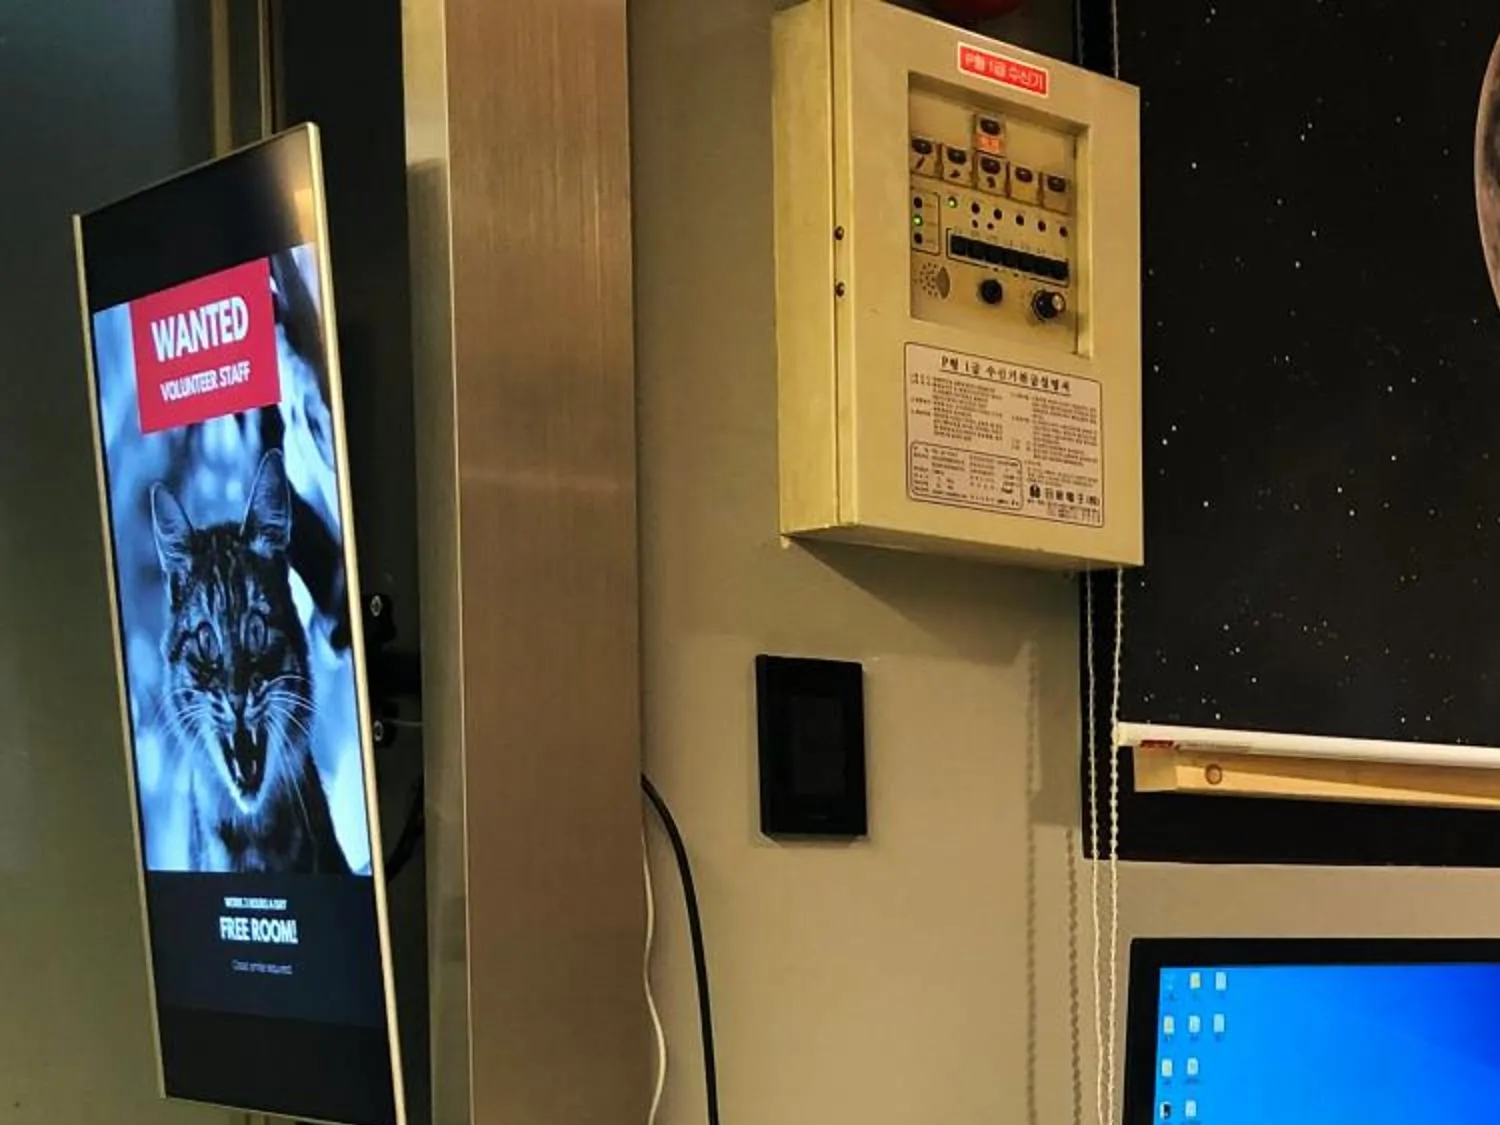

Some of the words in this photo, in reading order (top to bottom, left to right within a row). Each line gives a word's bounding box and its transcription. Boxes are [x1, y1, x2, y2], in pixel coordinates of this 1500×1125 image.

[1008, 66, 1045, 91] 수신기
[151, 295, 249, 363] WANTED
[160, 370, 218, 401] VOLUNTEER
[219, 360, 251, 387] STAFF
[219, 916, 250, 940] FREE
[251, 917, 299, 944] ROOM!
